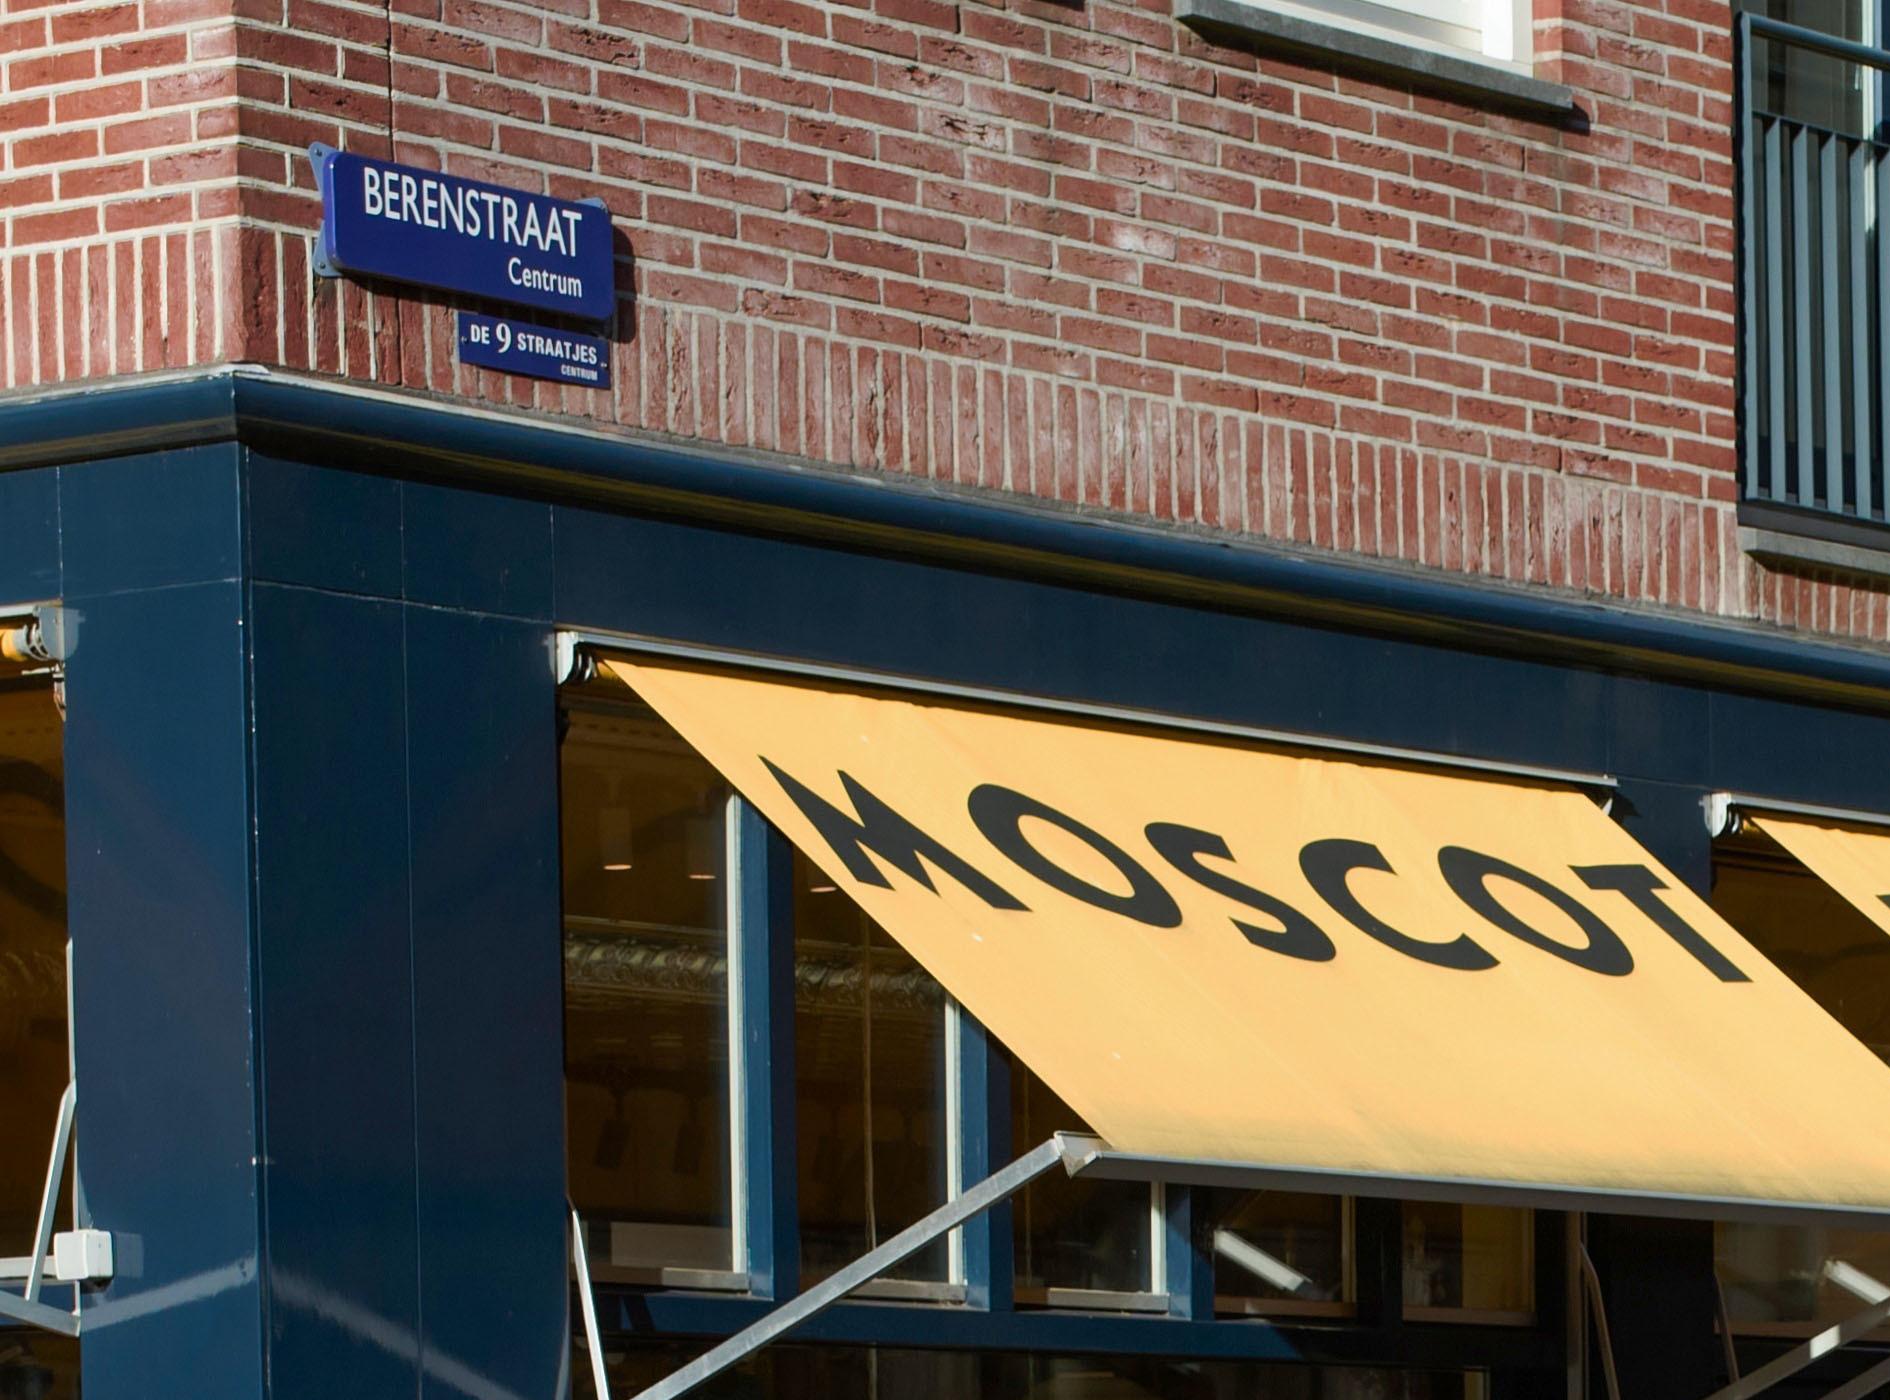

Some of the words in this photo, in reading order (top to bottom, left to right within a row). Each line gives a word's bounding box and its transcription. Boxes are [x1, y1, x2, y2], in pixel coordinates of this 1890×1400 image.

[364, 166, 582, 257] BERENSTRAAT
[508, 257, 582, 298] Centrum
[470, 324, 490, 344] DE
[496, 322, 511, 353] 9
[517, 333, 598, 365] STRAATJES
[561, 364, 598, 381] CENTRUM
[758, 755, 1752, 983] MOSCOT
